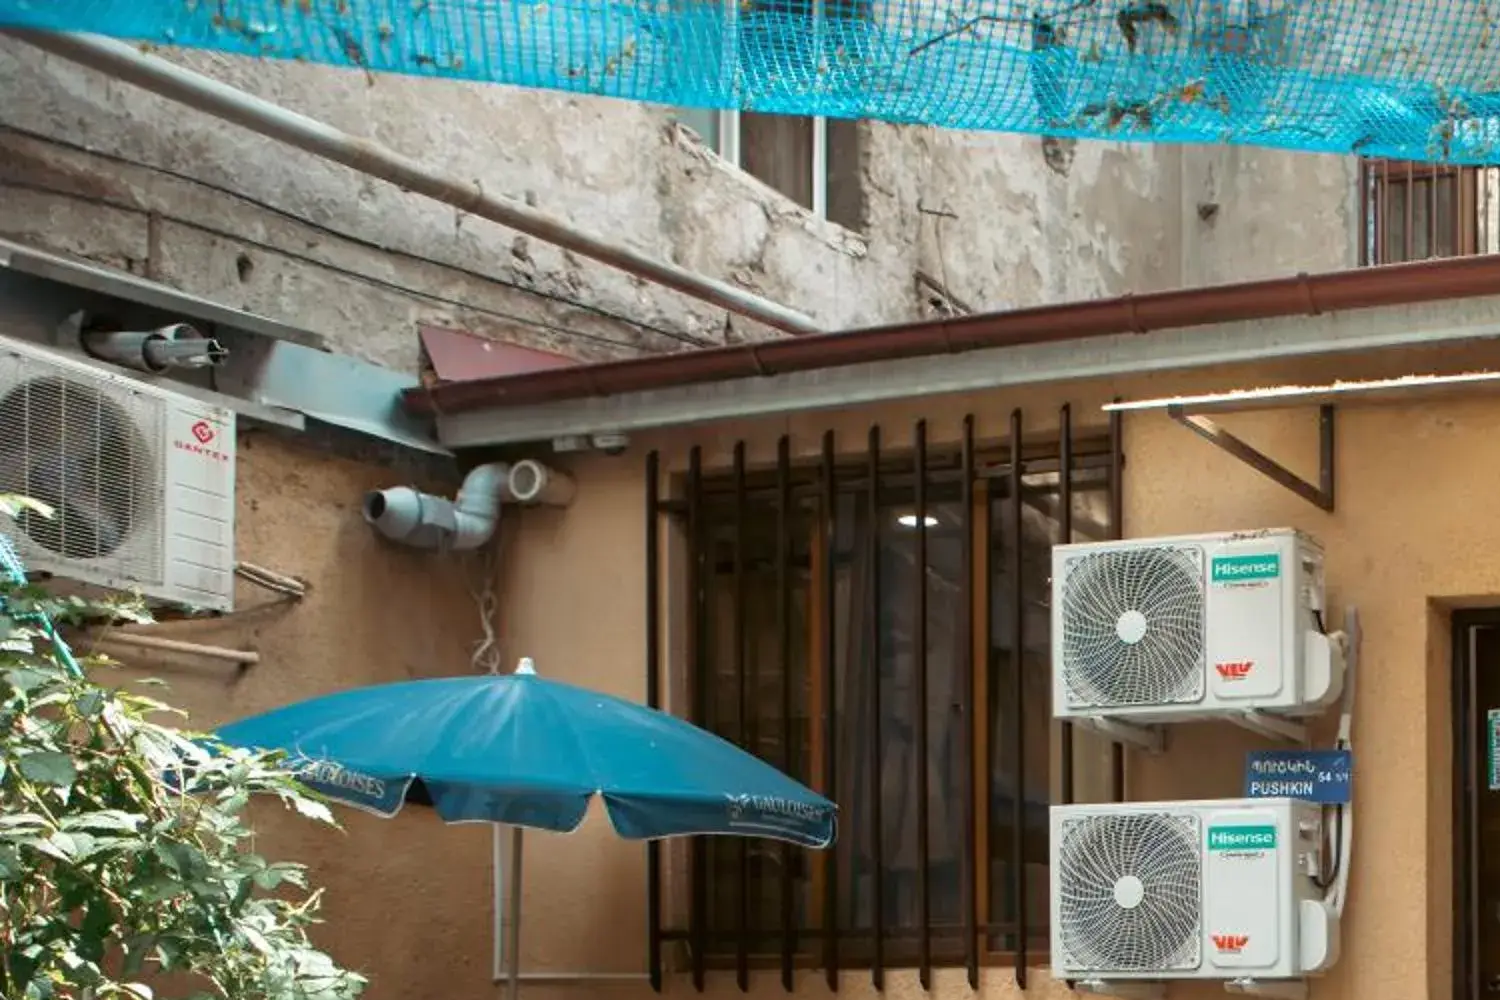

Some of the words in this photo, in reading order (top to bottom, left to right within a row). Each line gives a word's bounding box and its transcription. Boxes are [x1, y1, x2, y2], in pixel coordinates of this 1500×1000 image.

[1215, 562, 1277, 577] Hisense
[1251, 781, 1313, 795] PUSHKIN
[1211, 831, 1273, 845] Hisense
